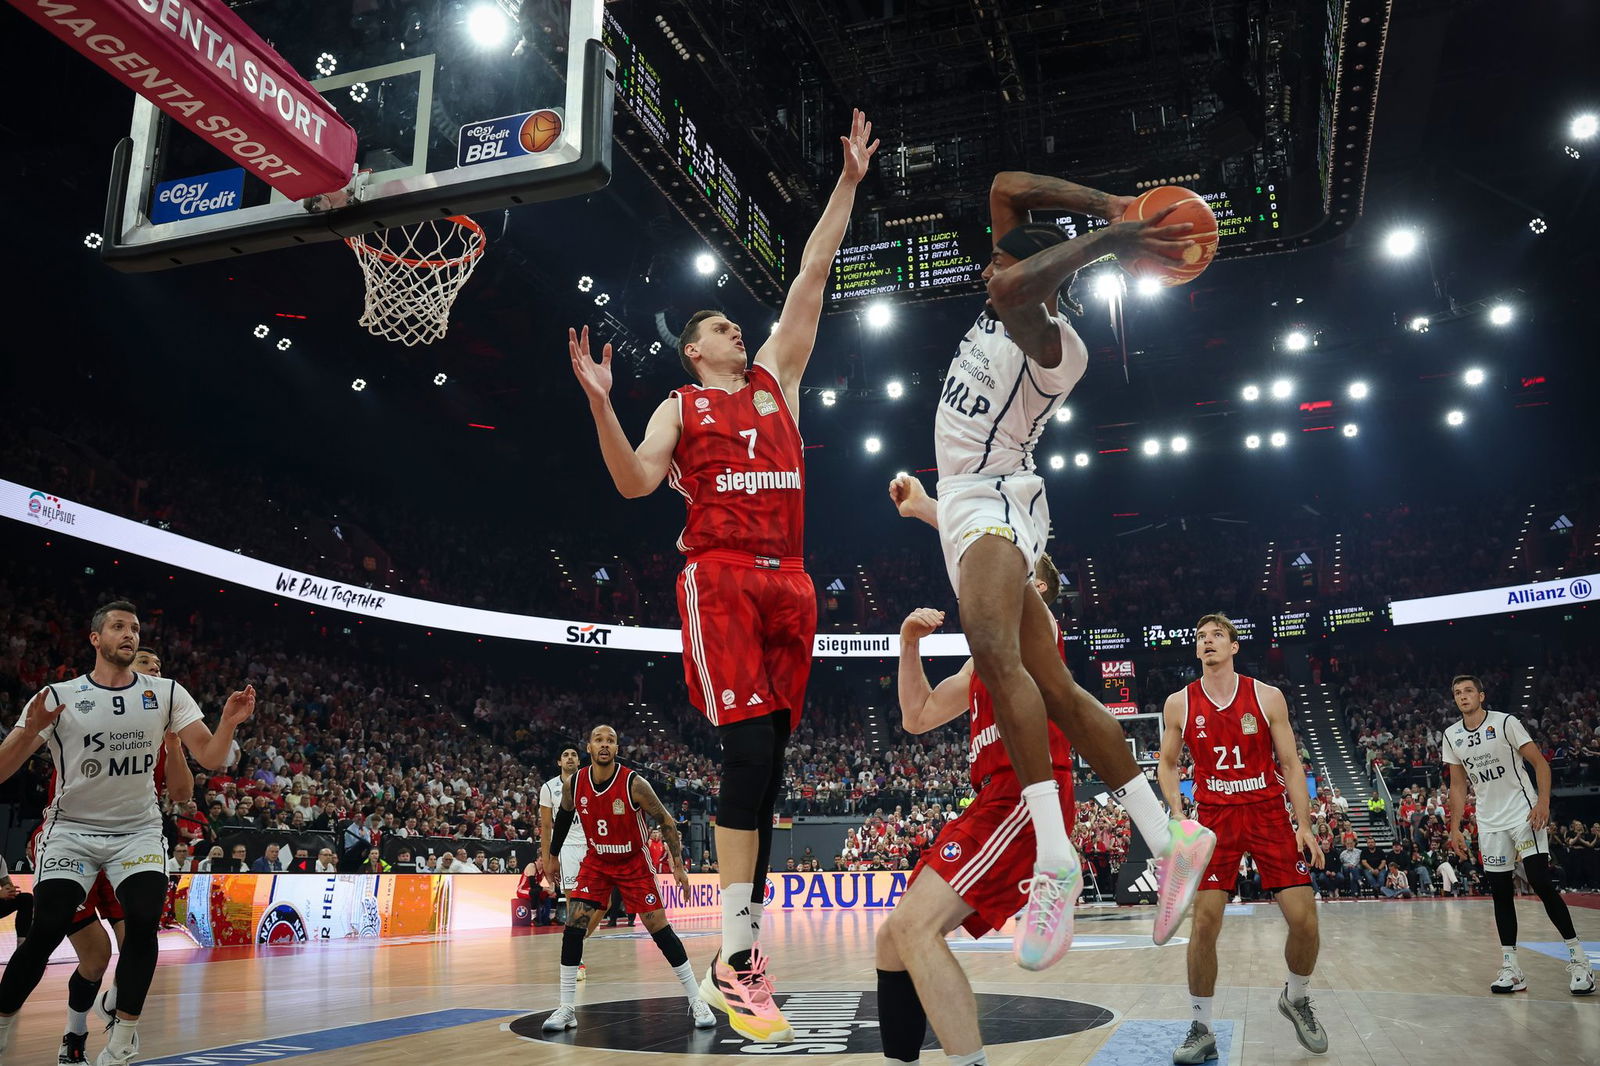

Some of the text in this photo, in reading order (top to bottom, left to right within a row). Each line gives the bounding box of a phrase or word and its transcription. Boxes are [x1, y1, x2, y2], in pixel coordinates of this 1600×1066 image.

[37, 0, 302, 180] MAGENTA SPORT
[243, 61, 327, 145] SPORT
[480, 129, 510, 142] Credit
[466, 140, 508, 163] BBL
[1268, 184, 1275, 192] 0
[179, 191, 236, 215] Credit
[931, 232, 951, 242] LUCIC
[931, 241, 950, 250] OBST
[843, 254, 866, 263] WHITE
[919, 253, 929, 261] 17
[932, 257, 963, 267] HOLLATZ
[843, 262, 868, 272] GIFFEY
[844, 269, 884, 280] VOIGTMANN
[933, 264, 974, 276] BRANKOVIC
[844, 280, 870, 289] NAPIER
[933, 275, 962, 285] BOOKER
[844, 285, 896, 298] KHARCHENKOV
[959, 359, 996, 390] solutions
[942, 376, 991, 418] MLP
[739, 428, 757, 459] 7
[716, 467, 801, 495] siegmund
[42, 505, 76, 525] HELPSIDE
[276, 572, 386, 611] WE BALL TOGETHER
[1507, 586, 1567, 605] Allianz
[1149, 629, 1166, 641] 24
[818, 637, 890, 655] siegmund
[1120, 687, 1130, 702] 9
[112, 696, 125, 715] 9
[110, 730, 144, 741] koenig
[1468, 732, 1481, 747] 33
[110, 740, 153, 752] solutions
[108, 754, 154, 776] MLP
[1213, 745, 1246, 770] 21
[1206, 772, 1267, 795] siegmund
[597, 819, 608, 836] 8
[782, 873, 906, 909] PAULA
